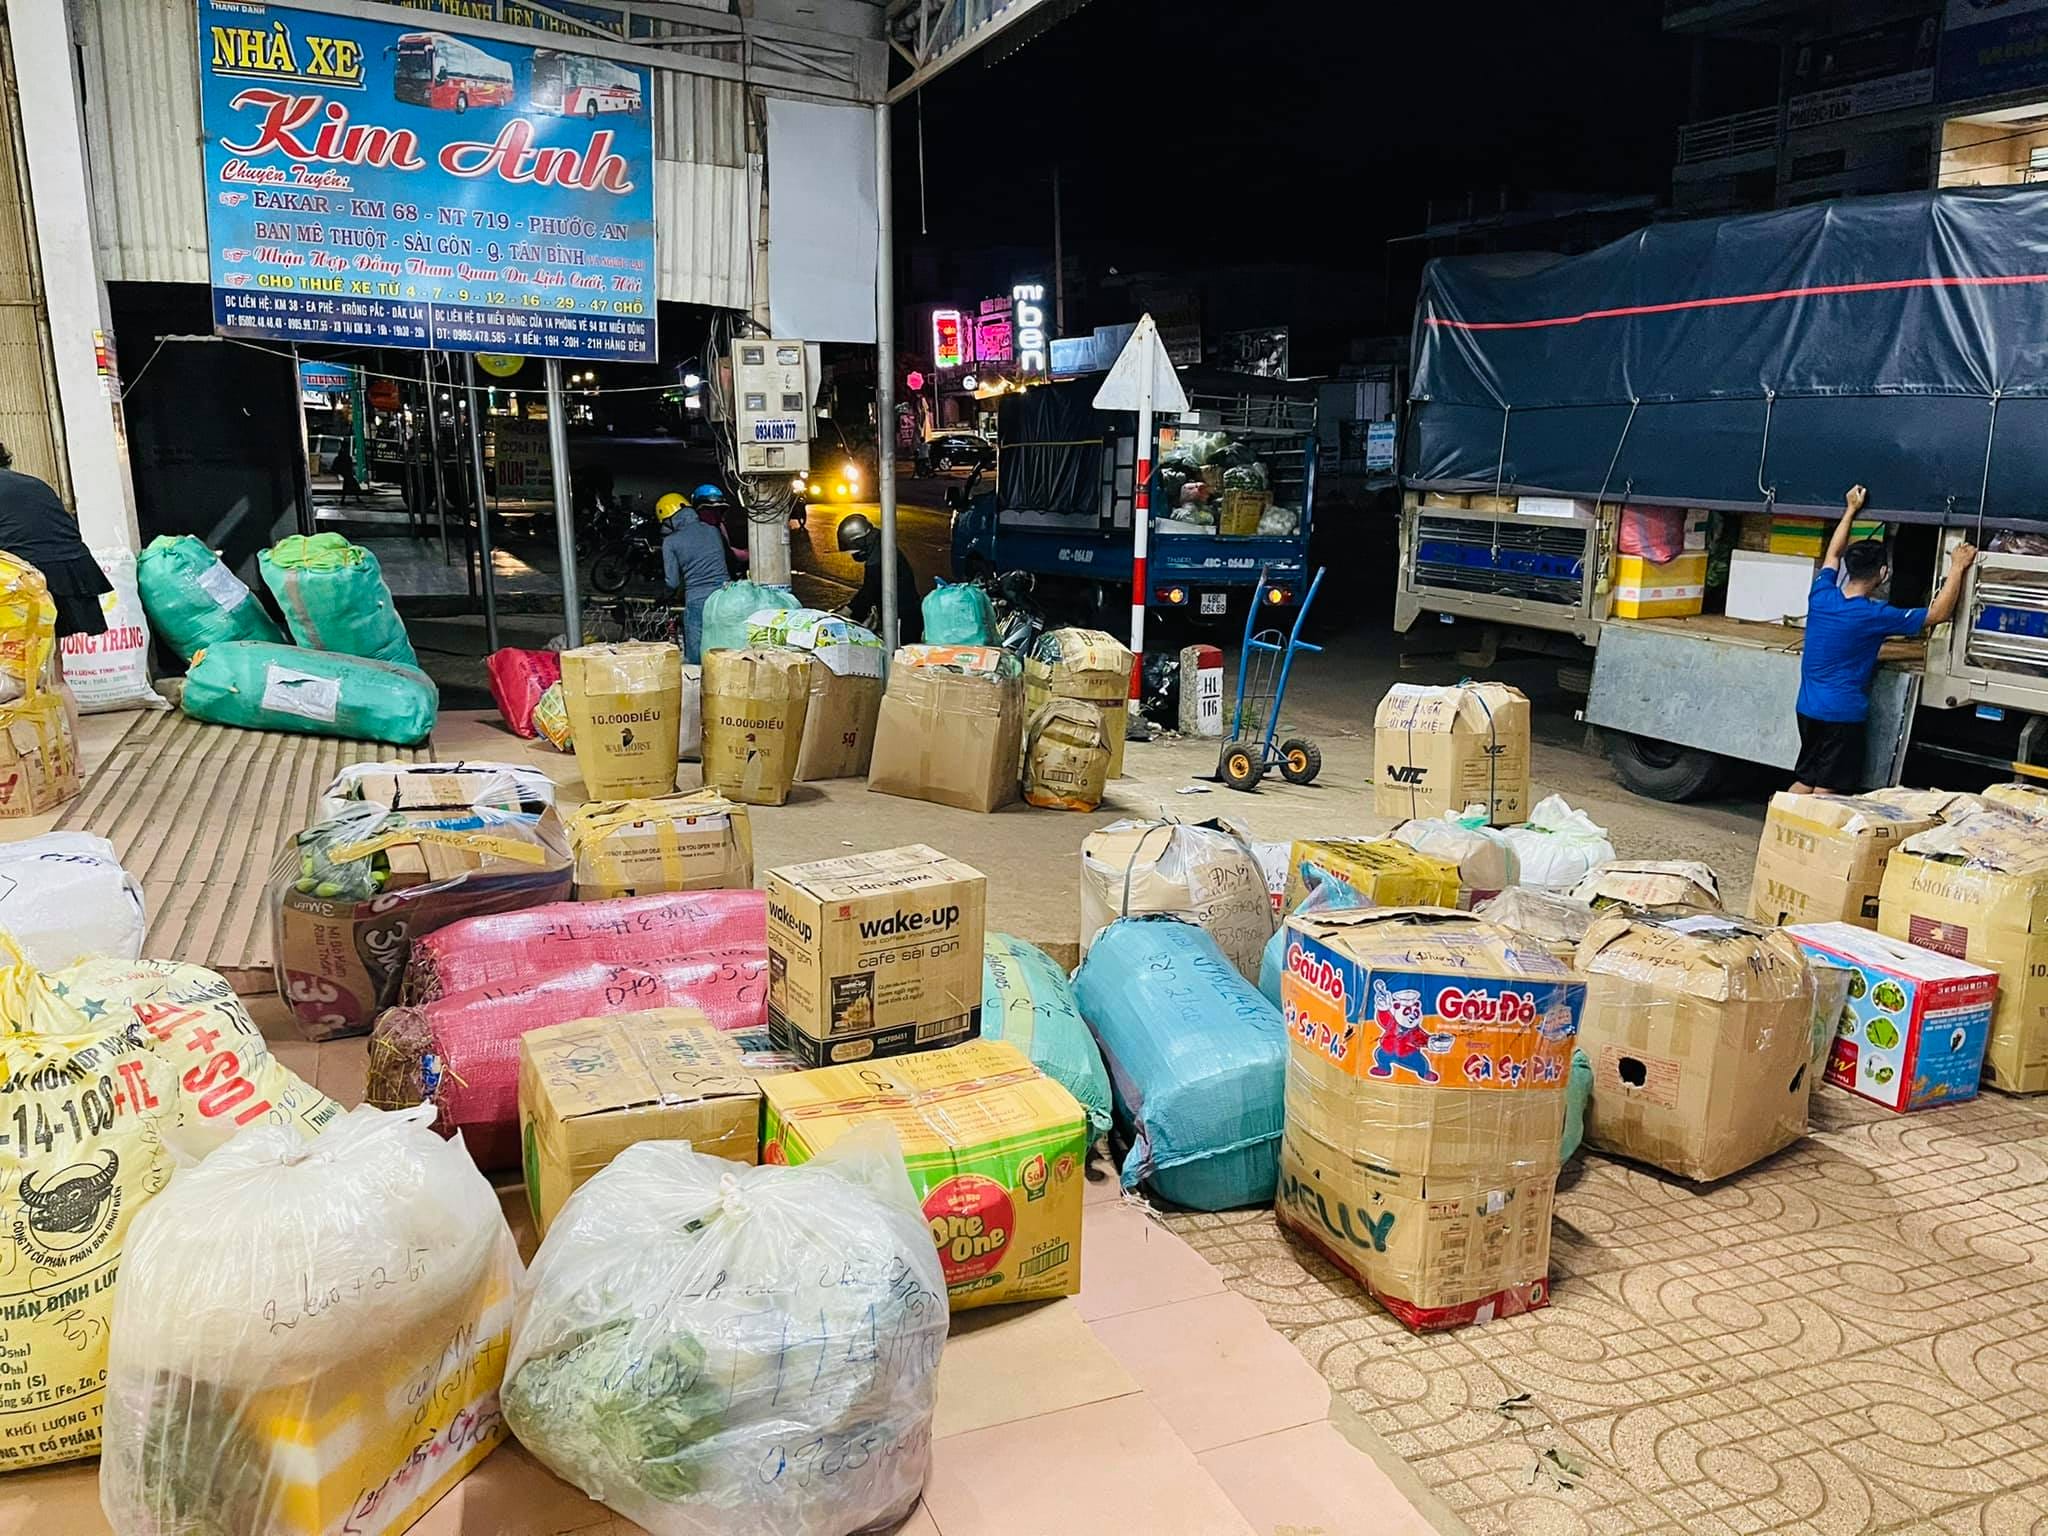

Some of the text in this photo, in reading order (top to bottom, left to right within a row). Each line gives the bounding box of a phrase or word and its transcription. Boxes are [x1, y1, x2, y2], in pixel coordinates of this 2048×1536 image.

[212, 22, 363, 80] NHÀ XE
[221, 89, 632, 194] Kim Anh
[221, 159, 349, 190] Chuyên Tuyến:
[254, 192, 628, 240] EAKAR KM 68 NT 719 PHƯỚC AN
[297, 222, 324, 243] MÊ
[330, 227, 387, 250] THUỘT
[404, 232, 432, 252] SÀI
[437, 234, 471, 256] GÒN
[487, 242, 504, 263] Q.
[510, 242, 540, 262] TÂN
[547, 244, 585, 266] BÌNH
[253, 247, 304, 269] Nhận
[309, 251, 349, 272] Hợp
[353, 254, 402, 276] Đồng
[407, 258, 452, 277] Tham
[457, 263, 499, 282] Quan
[502, 266, 528, 283] Du
[531, 269, 566, 289] Lịch
[238, 295, 256, 310] LIÊN
[258, 296, 272, 312] HỆ:
[274, 298, 287, 310] KM
[288, 298, 298, 311] 38
[306, 300, 316, 313] EA
[341, 301, 367, 317] KRÔNG
[257, 274, 294, 289] CHO
[300, 275, 344, 293] THUÊ
[351, 281, 372, 294] XE
[405, 287, 417, 298] 4
[432, 287, 443, 300] 7
[458, 289, 470, 302] 9
[486, 291, 505, 305] 12
[521, 294, 541, 306] 16
[556, 296, 575, 310] 29
[590, 299, 607, 312] 47
[612, 297, 644, 314] CHỖ
[1013, 285, 1044, 300] mr
[447, 308, 462, 323] LIÊN
[464, 309, 474, 325] HỆ
[544, 315, 552, 328] 1A
[554, 315, 576, 331] PHÒNG
[514, 335, 520, 344] X
[523, 333, 541, 346] BẾN:
[544, 336, 559, 347] 19H
[587, 337, 602, 350] 21H
[604, 337, 626, 351] HÀNG
[628, 338, 646, 352] ĐÊM
[1017, 300, 1044, 372] ben
[755, 423, 771, 440] 0934
[785, 423, 796, 440] 777
[101, 623, 144, 653] TRẮNG
[591, 709, 661, 726] 10.000ĐIẾU
[1203, 701, 1218, 717] 116
[719, 716, 784, 730] 10.000ĐIẾU
[1775, 826, 1819, 853] YETI
[1767, 879, 1810, 909] YETI
[859, 905, 960, 939] wake-up
[858, 940, 960, 969] café sài gòn
[1437, 987, 1497, 1022] Gấu
[1463, 1053, 1493, 1081] Gà
[1499, 1054, 1528, 1087] Sợi
[928, 1215, 985, 1250] One
[21, 1241, 35, 1256] TY
[371, 1266, 397, 1289] 2
[47, 1284, 90, 1311] ĐỊNH
[21, 1391, 33, 1406] số
[38, 1391, 52, 1402] TE
[56, 1384, 77, 1400] (Fe,
[27, 1373, 48, 1390] (S)
[5, 1413, 87, 1438] KHỐI LƯỢNG
[20, 1442, 38, 1457] TY
[40, 1434, 57, 1453] CỔ
